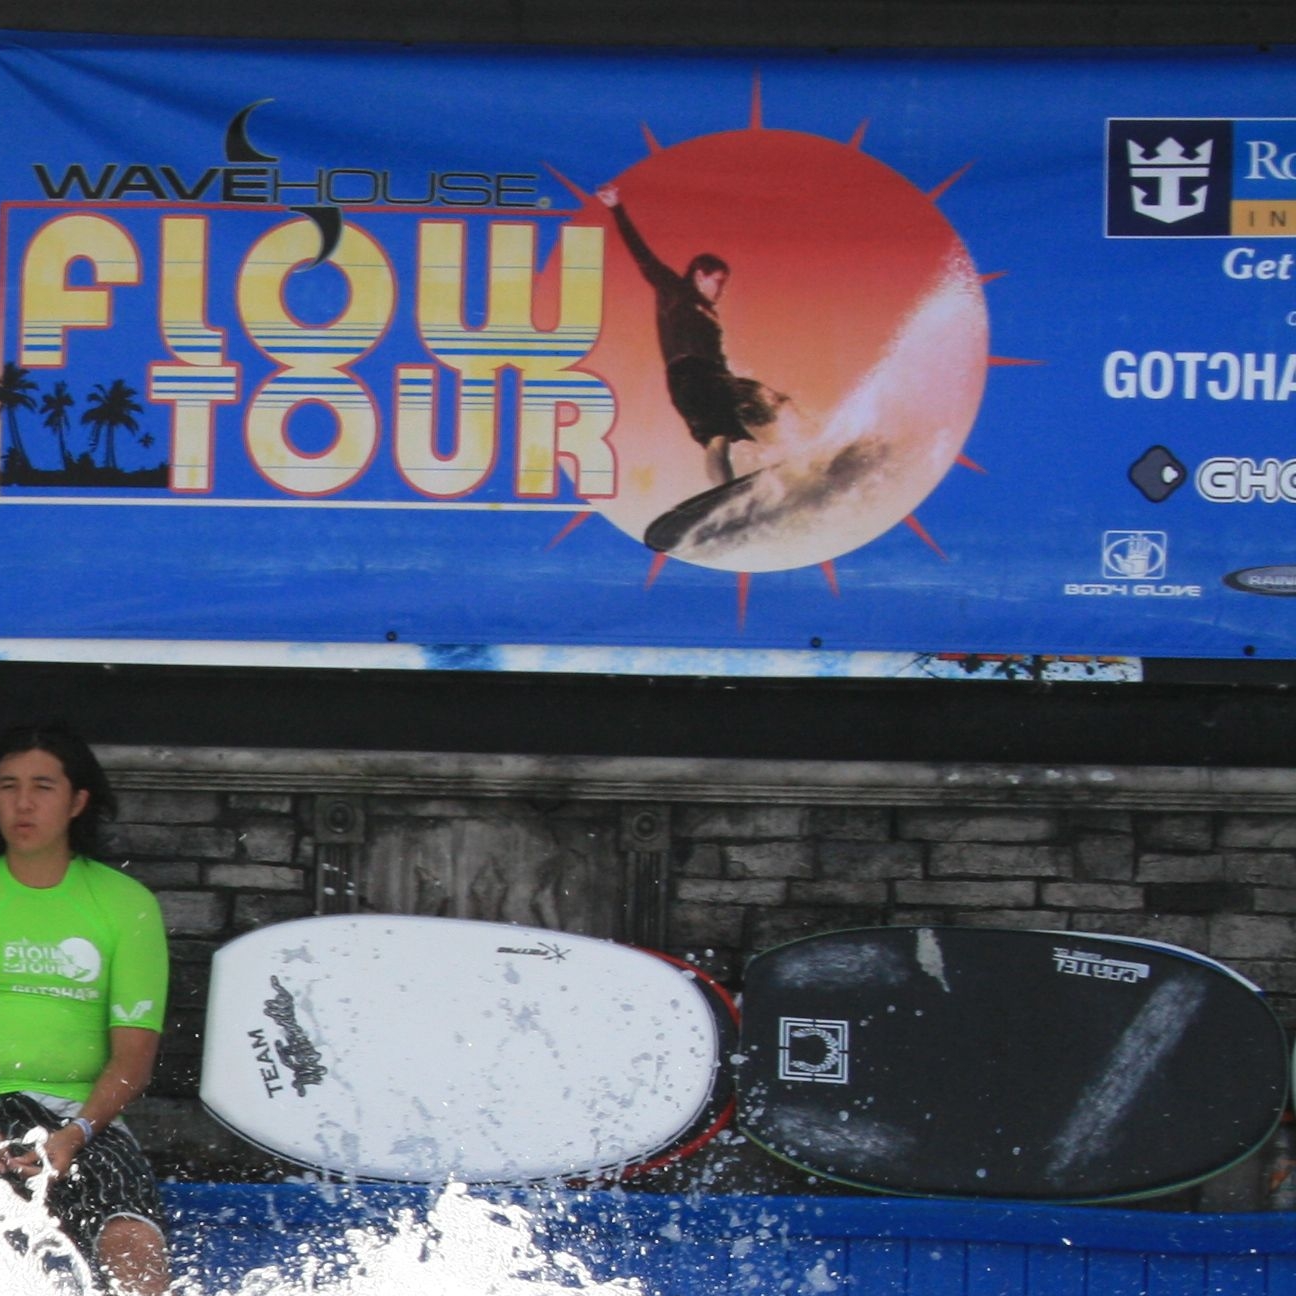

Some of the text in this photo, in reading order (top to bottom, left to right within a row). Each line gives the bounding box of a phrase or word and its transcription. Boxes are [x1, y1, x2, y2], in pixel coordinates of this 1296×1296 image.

[1223, 247, 1295, 280] Get
[18, 212, 607, 370] FLOW
[147, 363, 619, 498] TOUR
[1064, 583, 1202, 597] BODY GLOVE
[1051, 957, 1139, 984] CARTEL
[246, 1028, 284, 1099] TEAM
